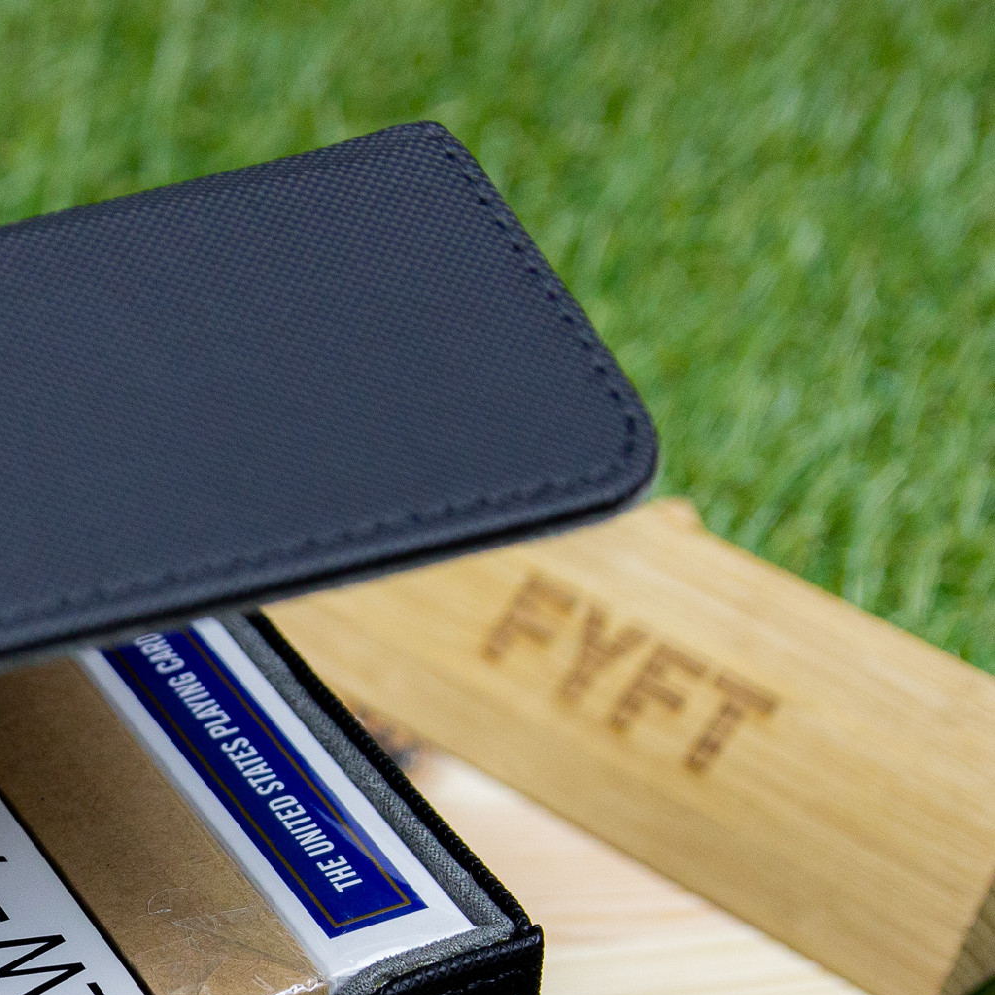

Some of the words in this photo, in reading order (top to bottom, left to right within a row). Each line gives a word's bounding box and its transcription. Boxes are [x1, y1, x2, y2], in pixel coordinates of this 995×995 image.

[134, 632, 185, 675] CARD
[480, 570, 782, 774] FYFT
[168, 672, 240, 740] PLAYING
[221, 736, 285, 796] STATES
[268, 794, 335, 857] UNITED
[316, 855, 363, 892] THE
